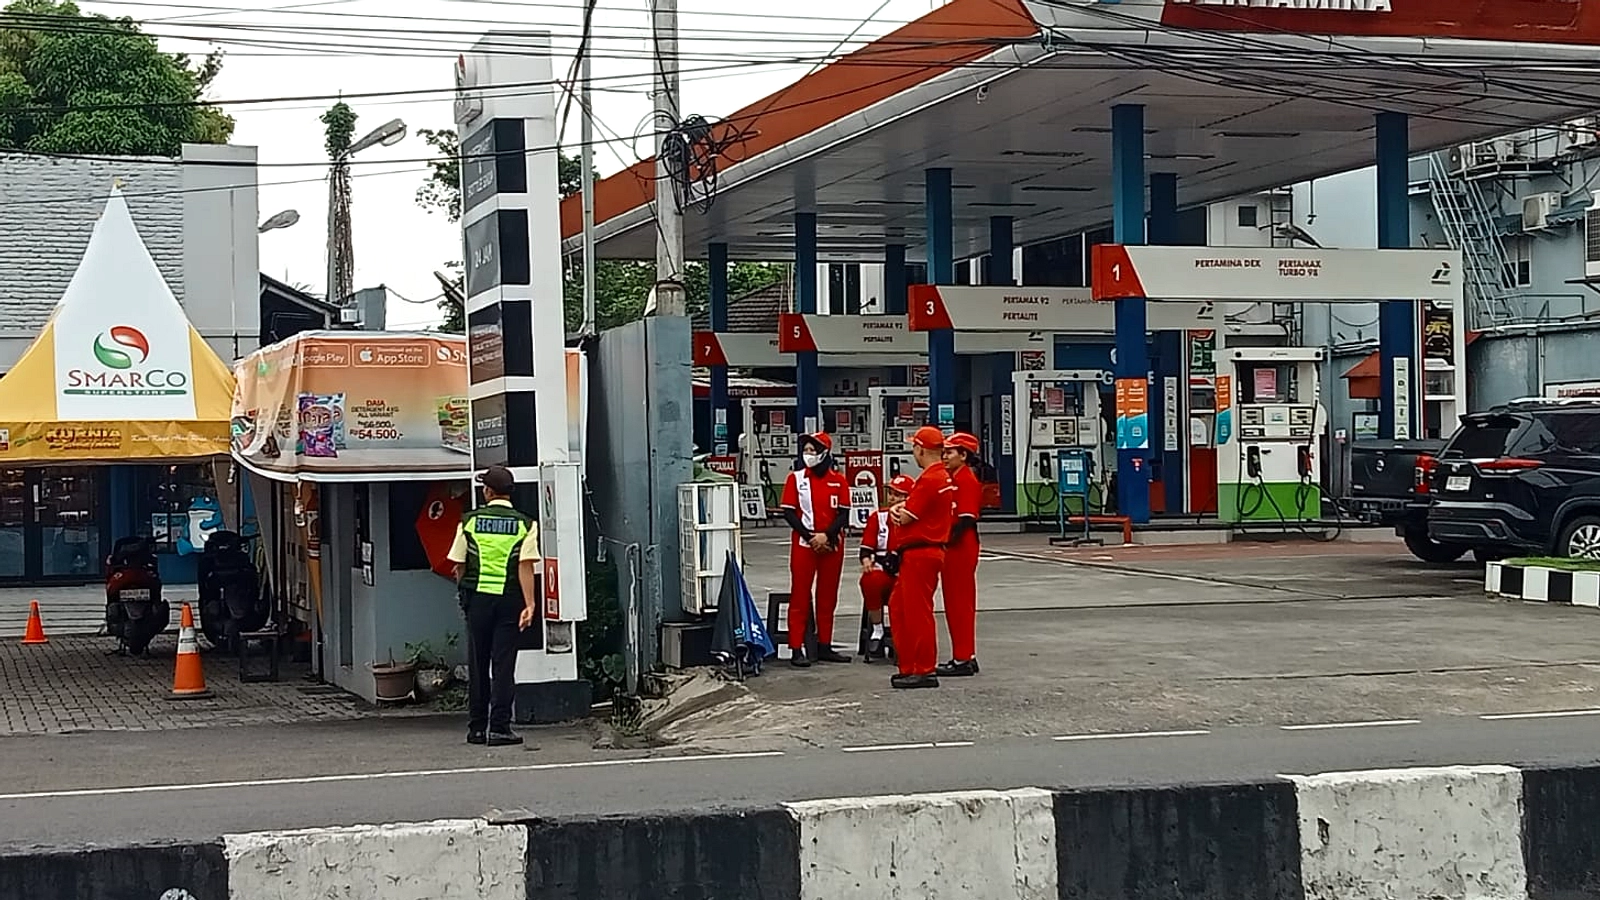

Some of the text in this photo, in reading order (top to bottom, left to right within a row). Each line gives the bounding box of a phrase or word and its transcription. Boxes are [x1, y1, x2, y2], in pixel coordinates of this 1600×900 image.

[1194, 259, 1261, 268] PERTAMINA DEX
[1278, 260, 1322, 268] PERTAMAX
[1112, 263, 1121, 281] 1
[1278, 268, 1319, 276] TURBO 98
[1002, 296, 1050, 305] PERTAMAX 92
[926, 301, 935, 315] 3
[1002, 312, 1038, 321] PERTALITE
[862, 322, 894, 330] PERTAMAX
[793, 326, 801, 339] 5
[704, 345, 711, 356] 7
[303, 353, 345, 364] oogle Play
[377, 353, 424, 364] App Store
[68, 369, 187, 388] SMARCO
[84, 389, 166, 397] SUPERSTORE
[365, 399, 386, 407] DAIA
[848, 456, 882, 467] PERTALITE
[476, 518, 518, 534] SECURITY
